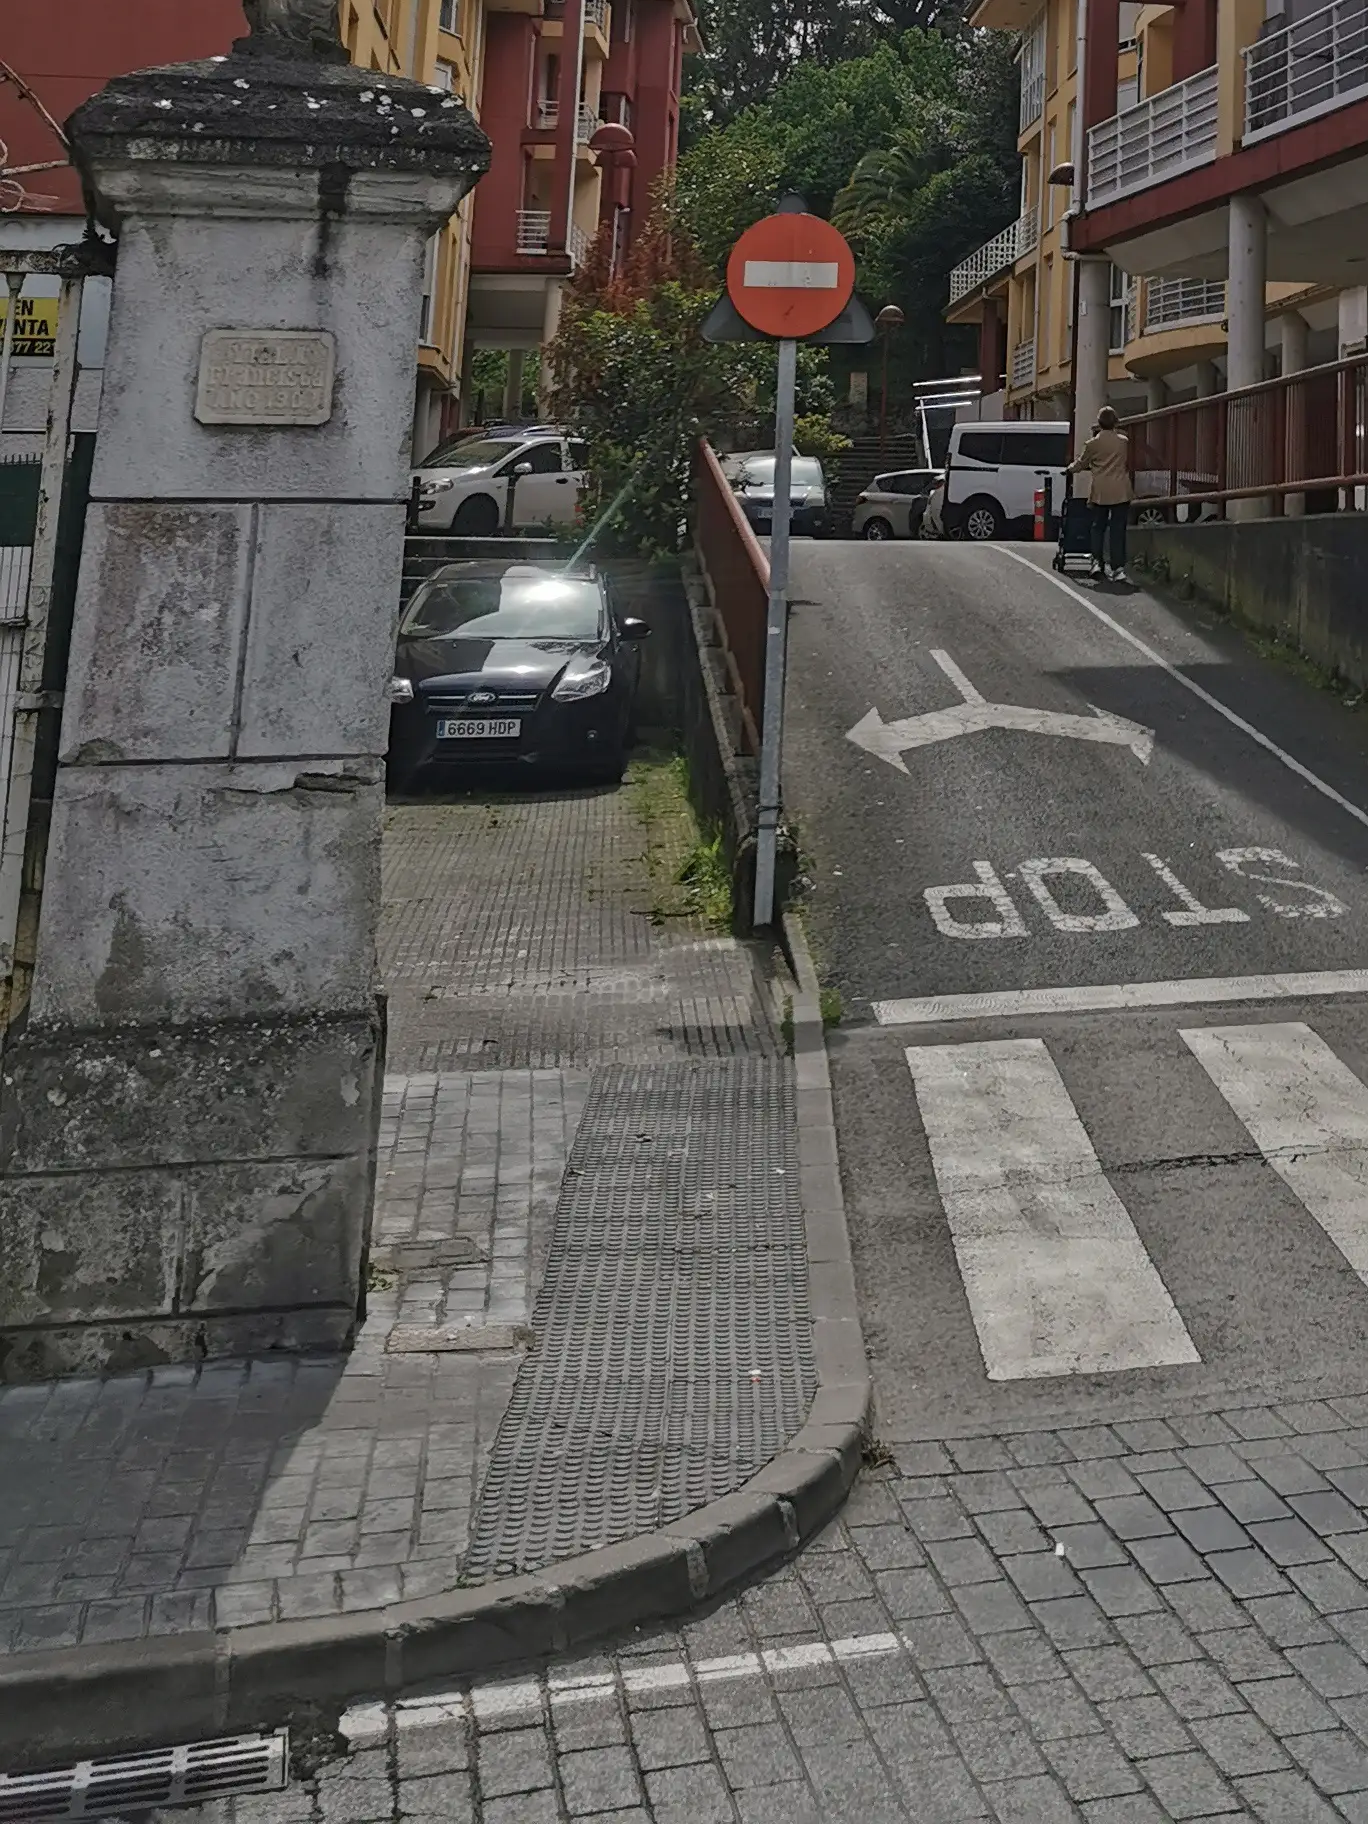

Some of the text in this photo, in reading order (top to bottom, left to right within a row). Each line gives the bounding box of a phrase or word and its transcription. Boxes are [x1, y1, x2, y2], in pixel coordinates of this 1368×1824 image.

[448, 721, 516, 736] 6669 HDP
[923, 846, 1350, 940] STOP
